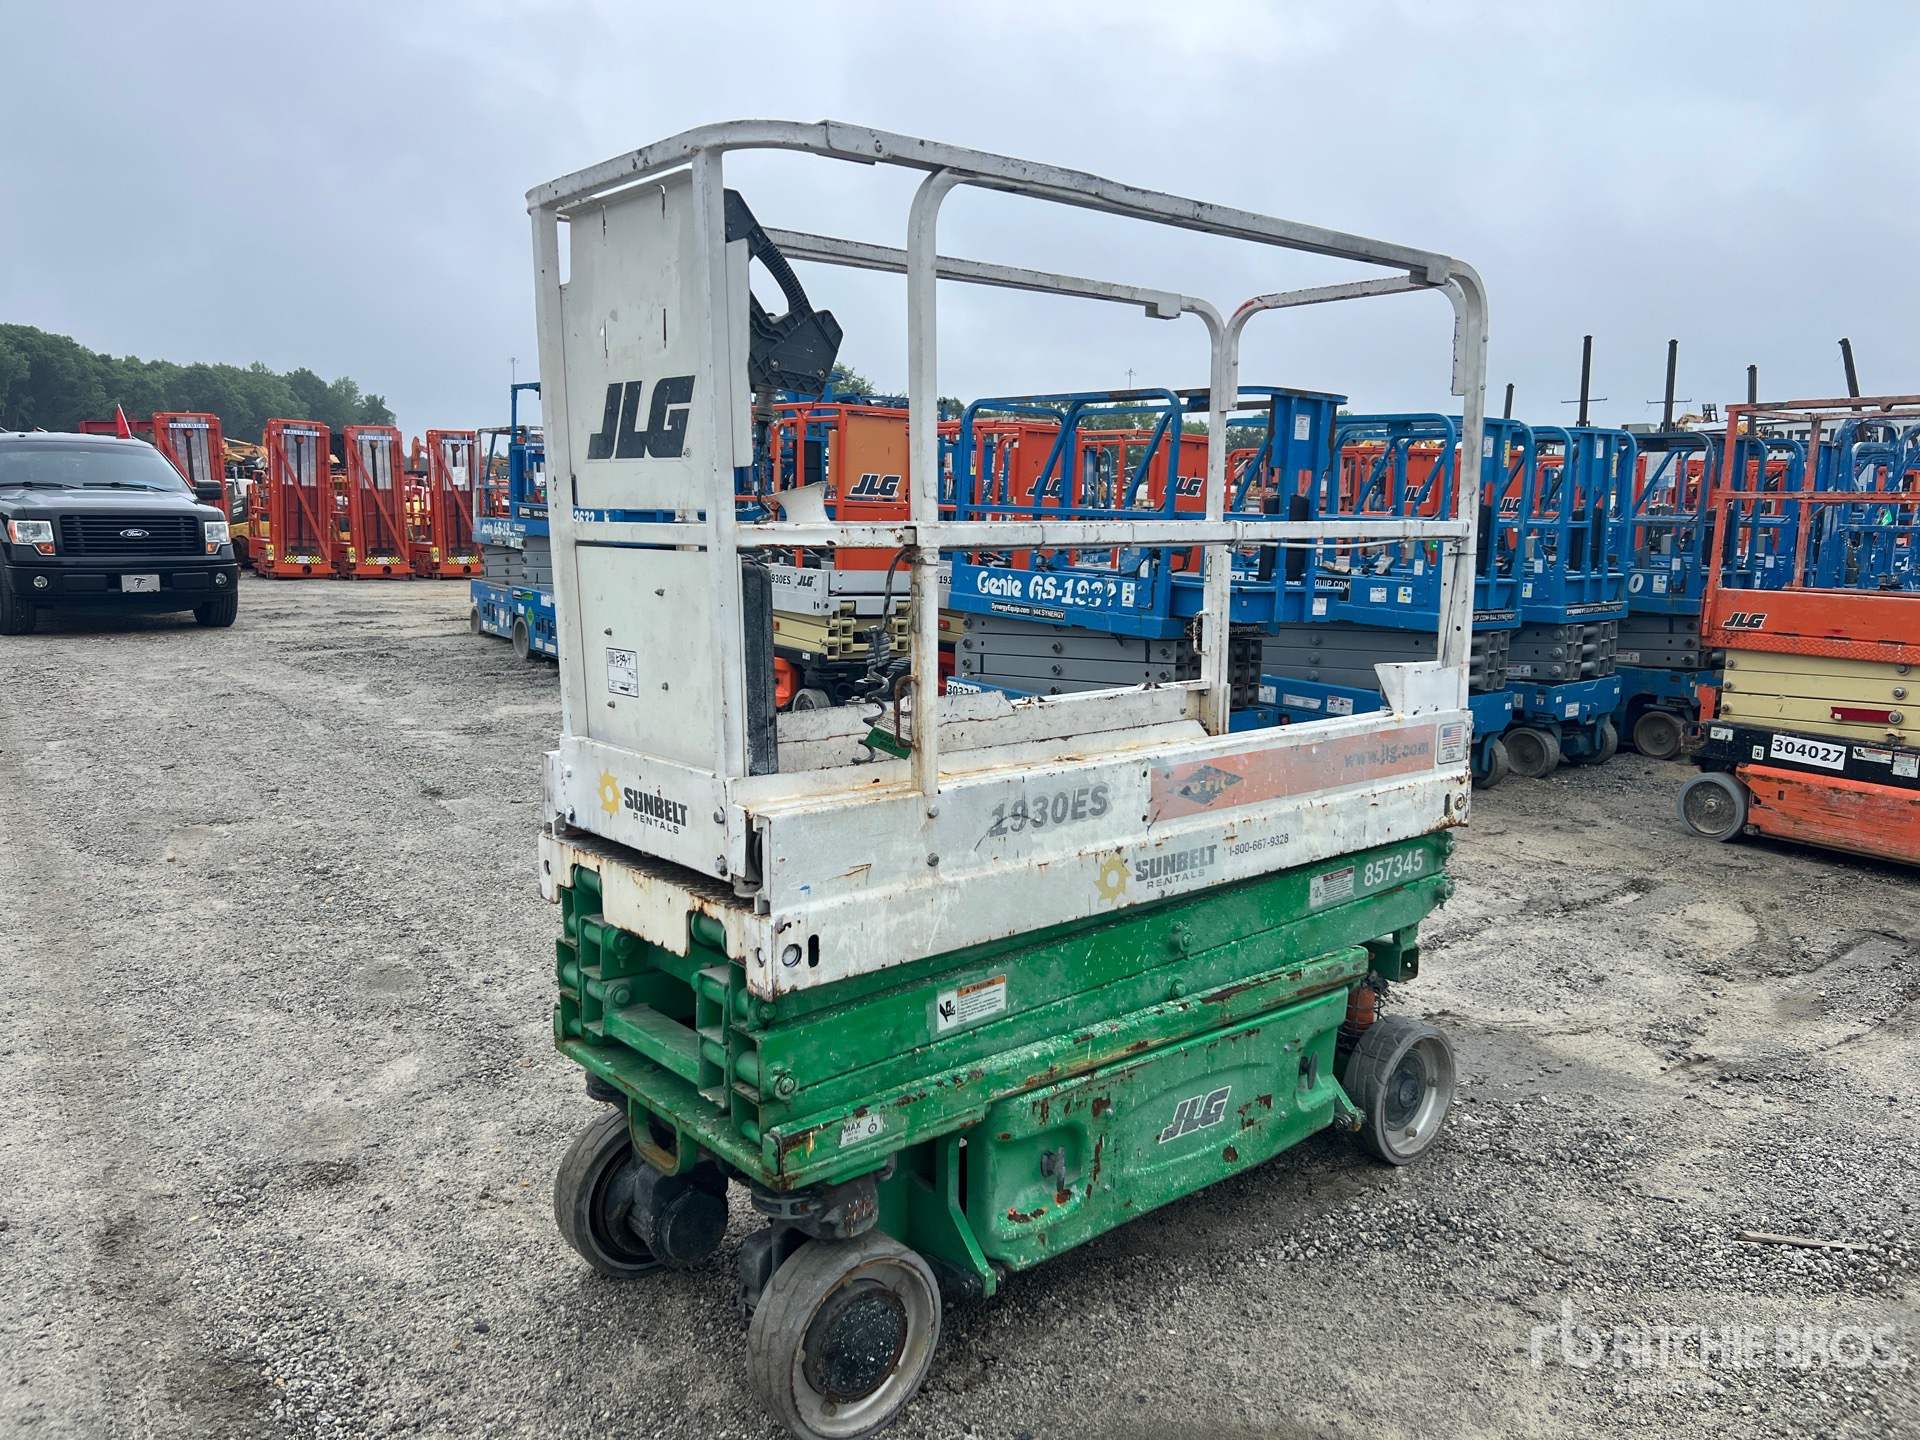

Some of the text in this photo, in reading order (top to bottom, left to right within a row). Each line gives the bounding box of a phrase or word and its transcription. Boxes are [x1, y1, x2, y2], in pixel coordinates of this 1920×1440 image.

[588, 375, 695, 459] JLG
[850, 474, 901, 497] JLG
[797, 575, 815, 588] JLG
[977, 570, 1023, 597] Genie
[1722, 612, 1767, 630] JLG
[1772, 739, 1845, 763] 304027
[624, 787, 687, 826] SUNBELT
[989, 785, 1108, 837] 1930ES
[633, 812, 679, 834] RENTALS
[1135, 833, 1290, 882] SUNBELT 1-800-667-9328
[1364, 848, 1424, 887] 857345
[1146, 869, 1205, 889] RENTALS
[843, 1121, 861, 1133] MAX
[1159, 1085, 1232, 1144] JLG
